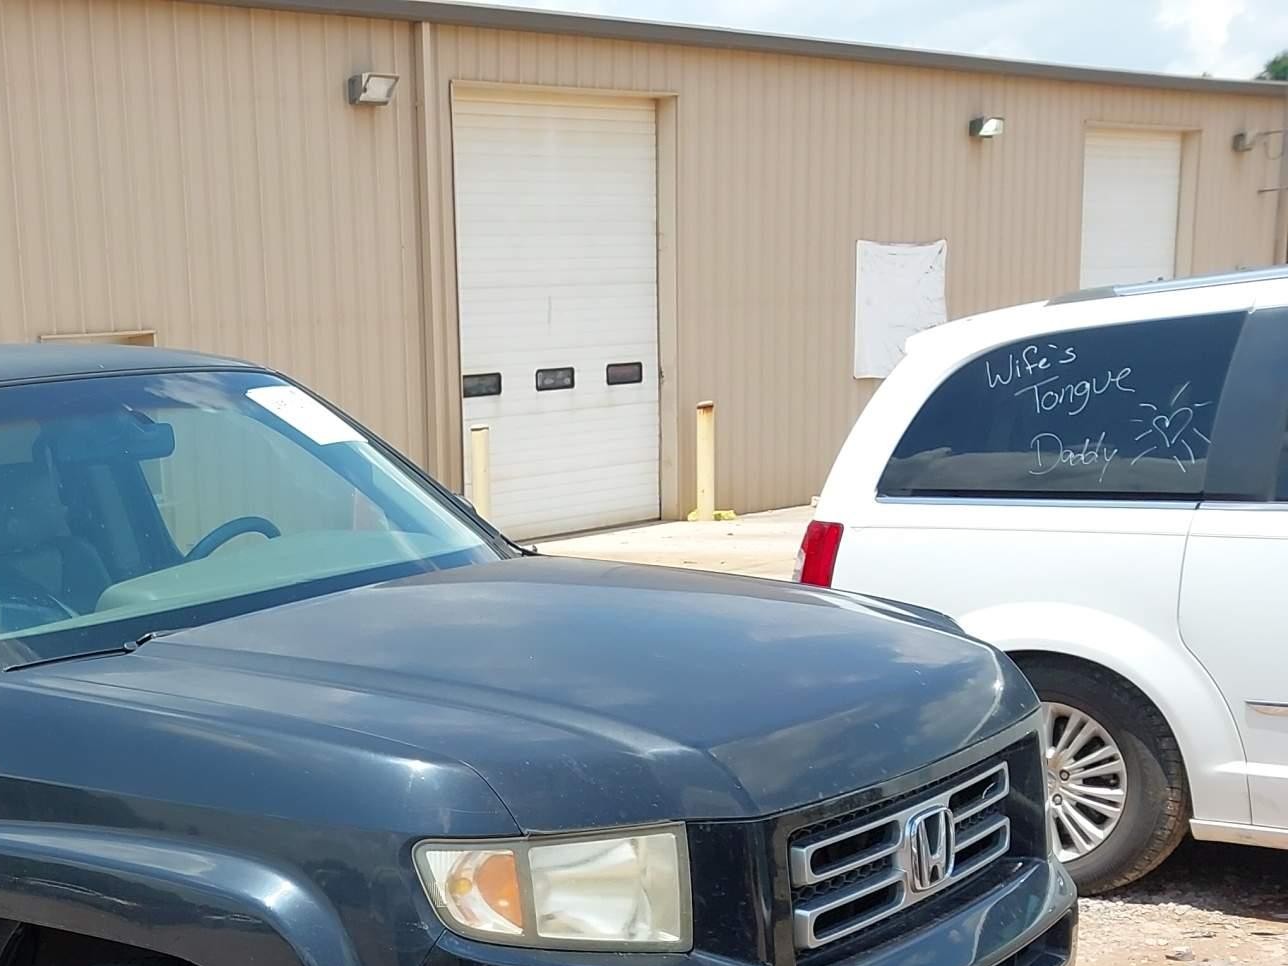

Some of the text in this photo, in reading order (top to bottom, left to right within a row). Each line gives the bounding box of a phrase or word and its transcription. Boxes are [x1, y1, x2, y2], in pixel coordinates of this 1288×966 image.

[985, 344, 1078, 390] Wife's
[1014, 367, 1136, 416] Tongue
[1028, 431, 1119, 483] Daddy
